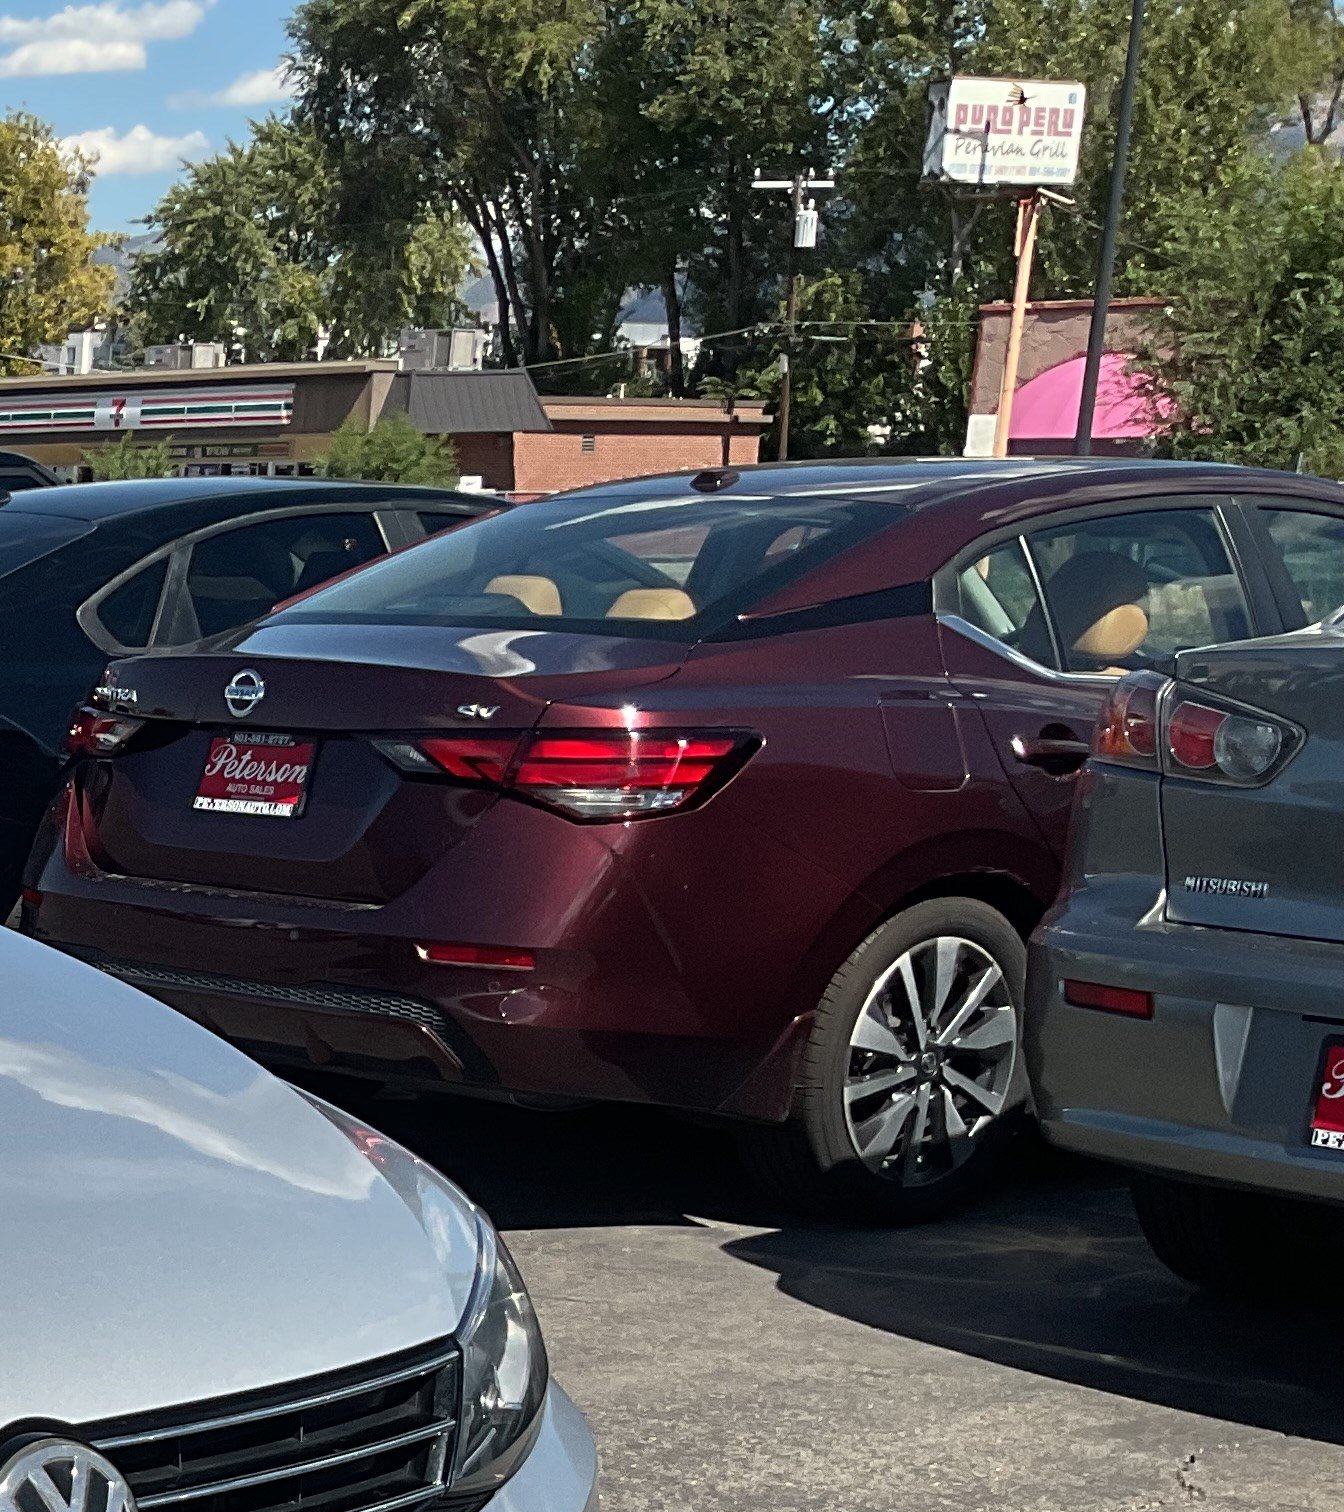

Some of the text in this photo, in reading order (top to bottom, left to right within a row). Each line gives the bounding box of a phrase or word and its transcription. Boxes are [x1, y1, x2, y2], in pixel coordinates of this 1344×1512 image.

[1029, 139, 1068, 158] Grill
[204, 743, 308, 784] Peterson
[226, 783, 275, 796] AUTO SALES
[1184, 876, 1269, 898] MITSUBISHI
